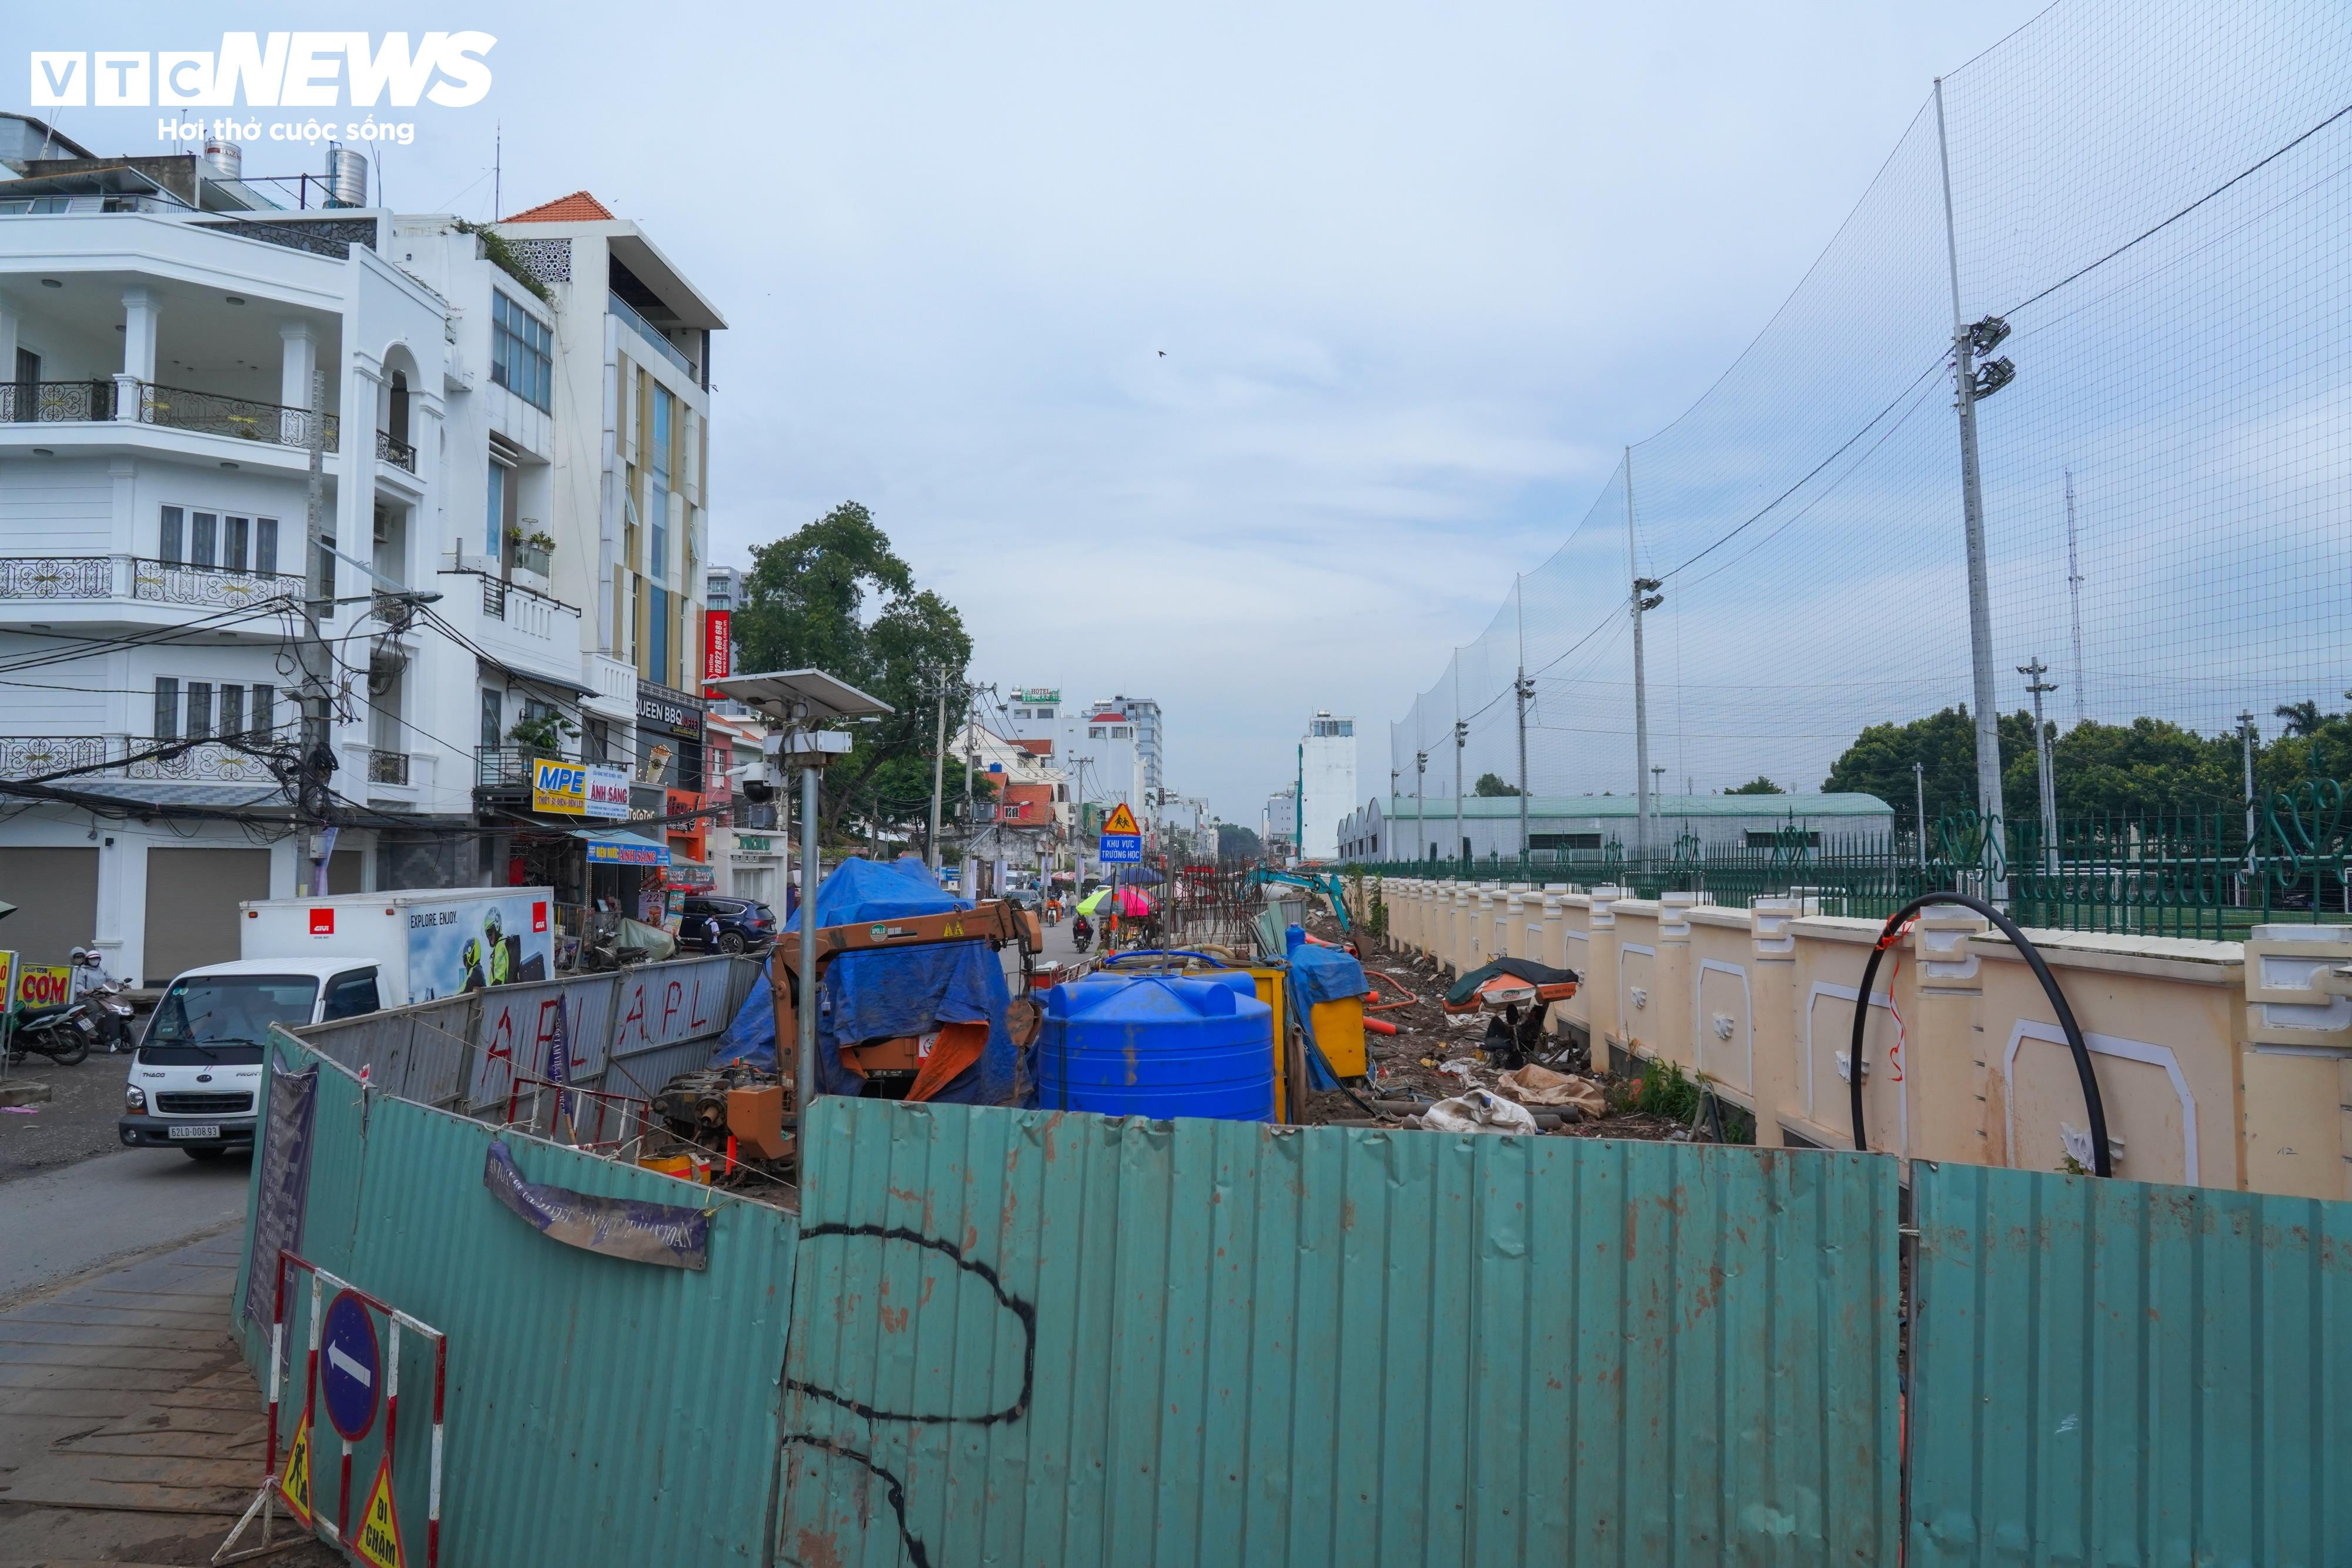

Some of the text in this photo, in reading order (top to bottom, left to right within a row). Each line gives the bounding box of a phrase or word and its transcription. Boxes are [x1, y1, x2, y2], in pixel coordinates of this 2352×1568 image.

[664, 706, 682, 725] BBQ
[681, 717, 699, 730] BUFFET
[537, 765, 586, 793] MPE
[590, 781, 627, 804] ÁNH SÁNG
[619, 845, 635, 862] ÁNH
[636, 847, 656, 863] SÁNG
[1102, 849, 1140, 860] TRƯỜNG HỌC
[1107, 839, 1134, 849] KHU VỰC
[411, 911, 457, 928] EXPLORE. ENJOY.
[22, 971, 67, 1003] CƠM
[172, 1127, 217, 1136] 62LD-008.93
[377, 1496, 387, 1524] ĐI
[366, 1523, 396, 1567] CHẬM
